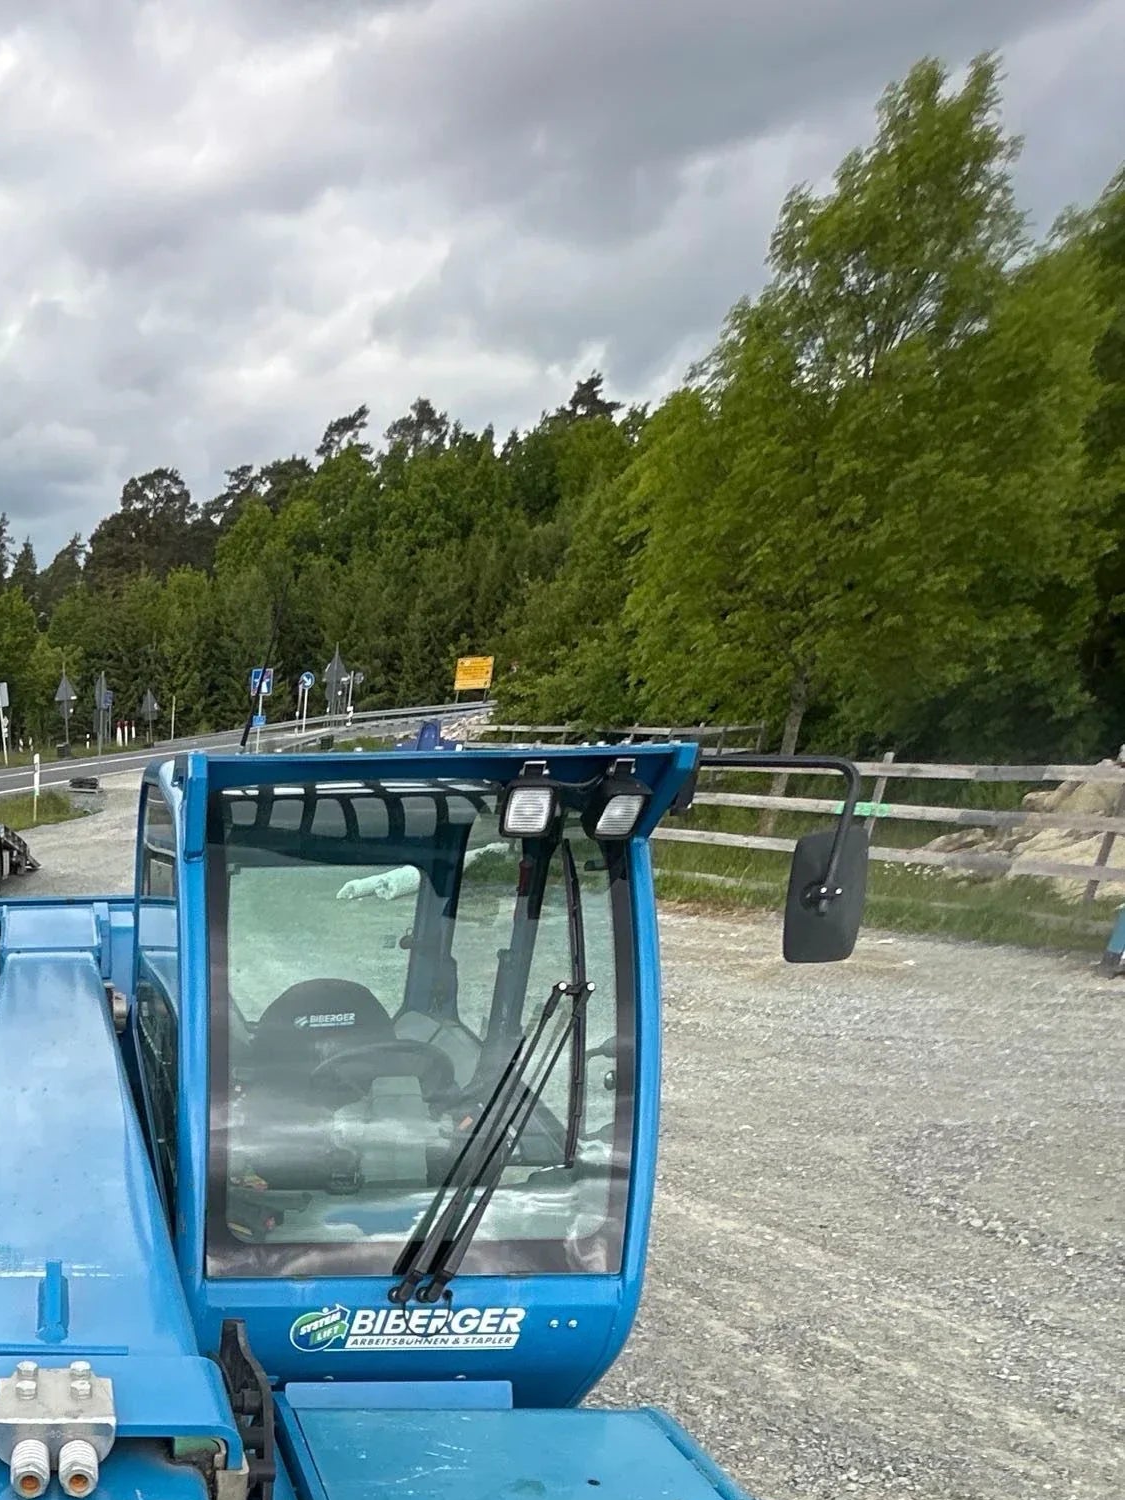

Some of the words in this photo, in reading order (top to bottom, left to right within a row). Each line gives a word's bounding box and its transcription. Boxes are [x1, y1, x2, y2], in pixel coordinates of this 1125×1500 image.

[309, 1013, 355, 1023] BIBERGER
[299, 1311, 342, 1335] SYSTEM
[350, 1308, 526, 1335] BIBERGER
[463, 1336, 513, 1345] STAPLER
